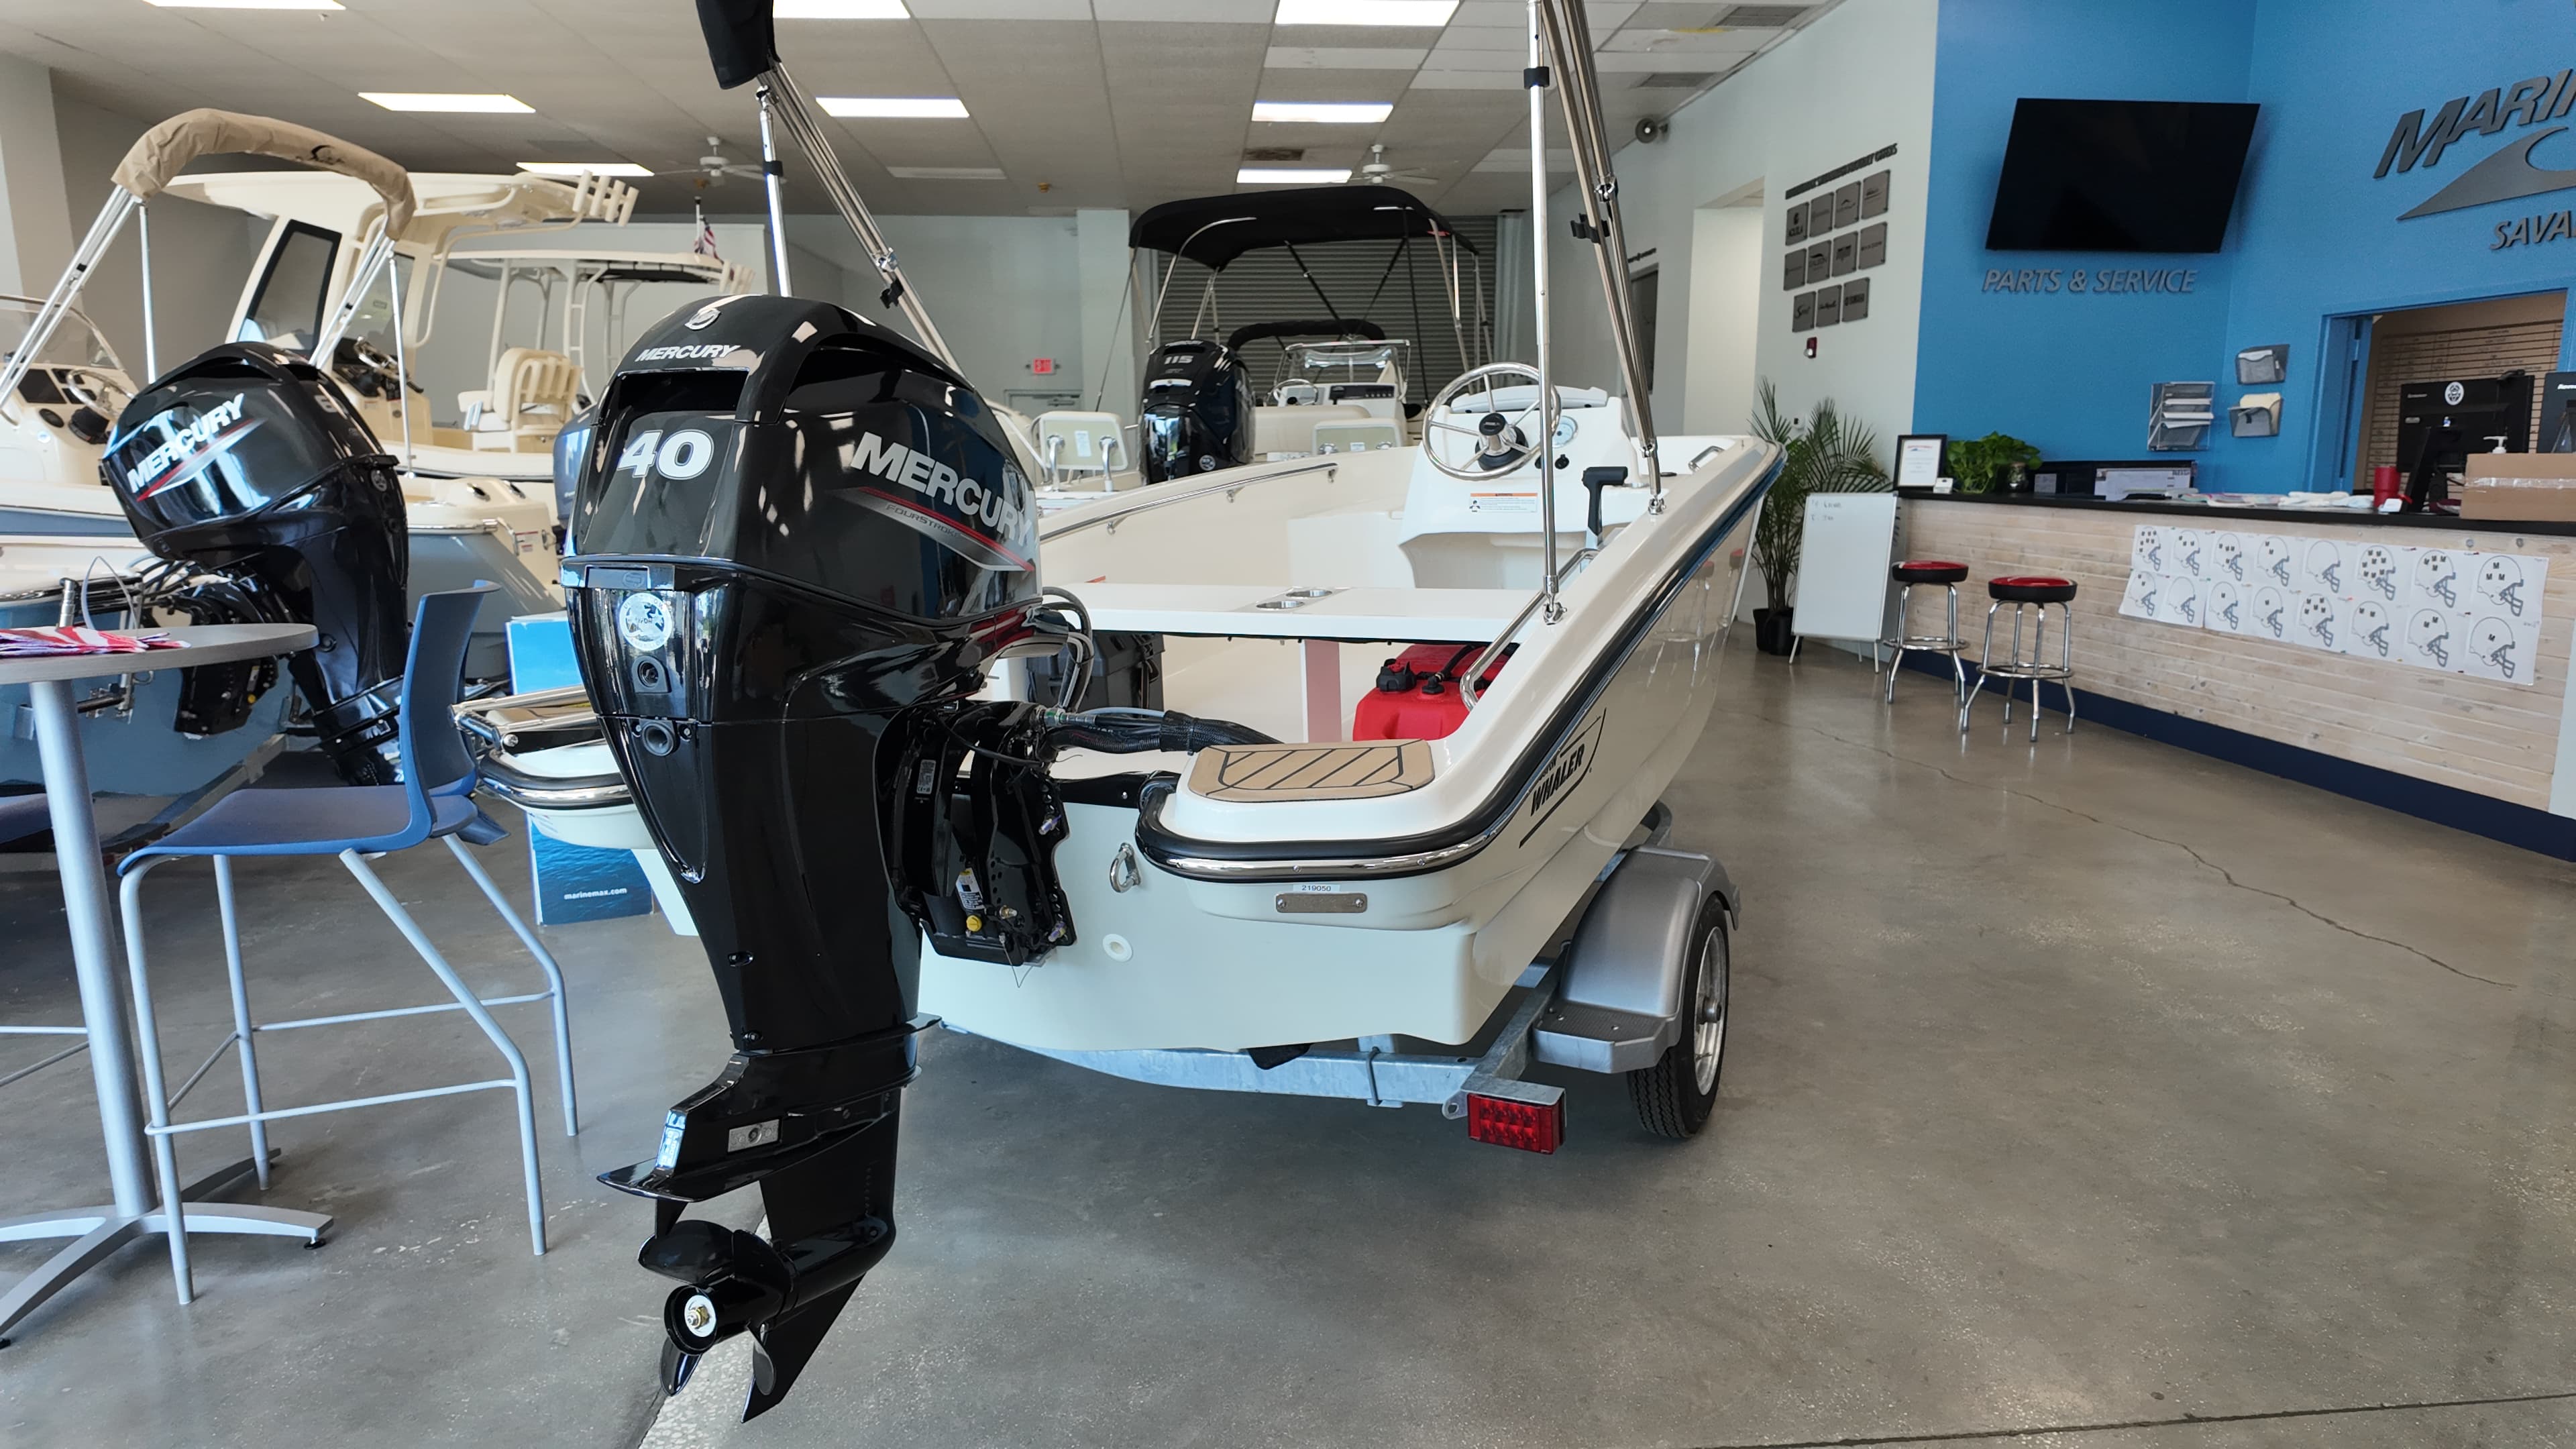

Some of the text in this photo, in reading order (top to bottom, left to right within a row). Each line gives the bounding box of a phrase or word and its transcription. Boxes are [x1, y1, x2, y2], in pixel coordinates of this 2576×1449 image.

[2489, 210, 2576, 250] SAVA
[1982, 268, 2199, 293] PARTS & SERVICE
[635, 345, 741, 362] MERCURY
[1164, 355, 1194, 364] 115
[127, 393, 245, 493] MERCURY
[616, 429, 714, 480] 40
[850, 431, 1032, 547] MERCURY
[1530, 743, 1585, 817] WHALER
[564, 888, 628, 900] marinemax.com
